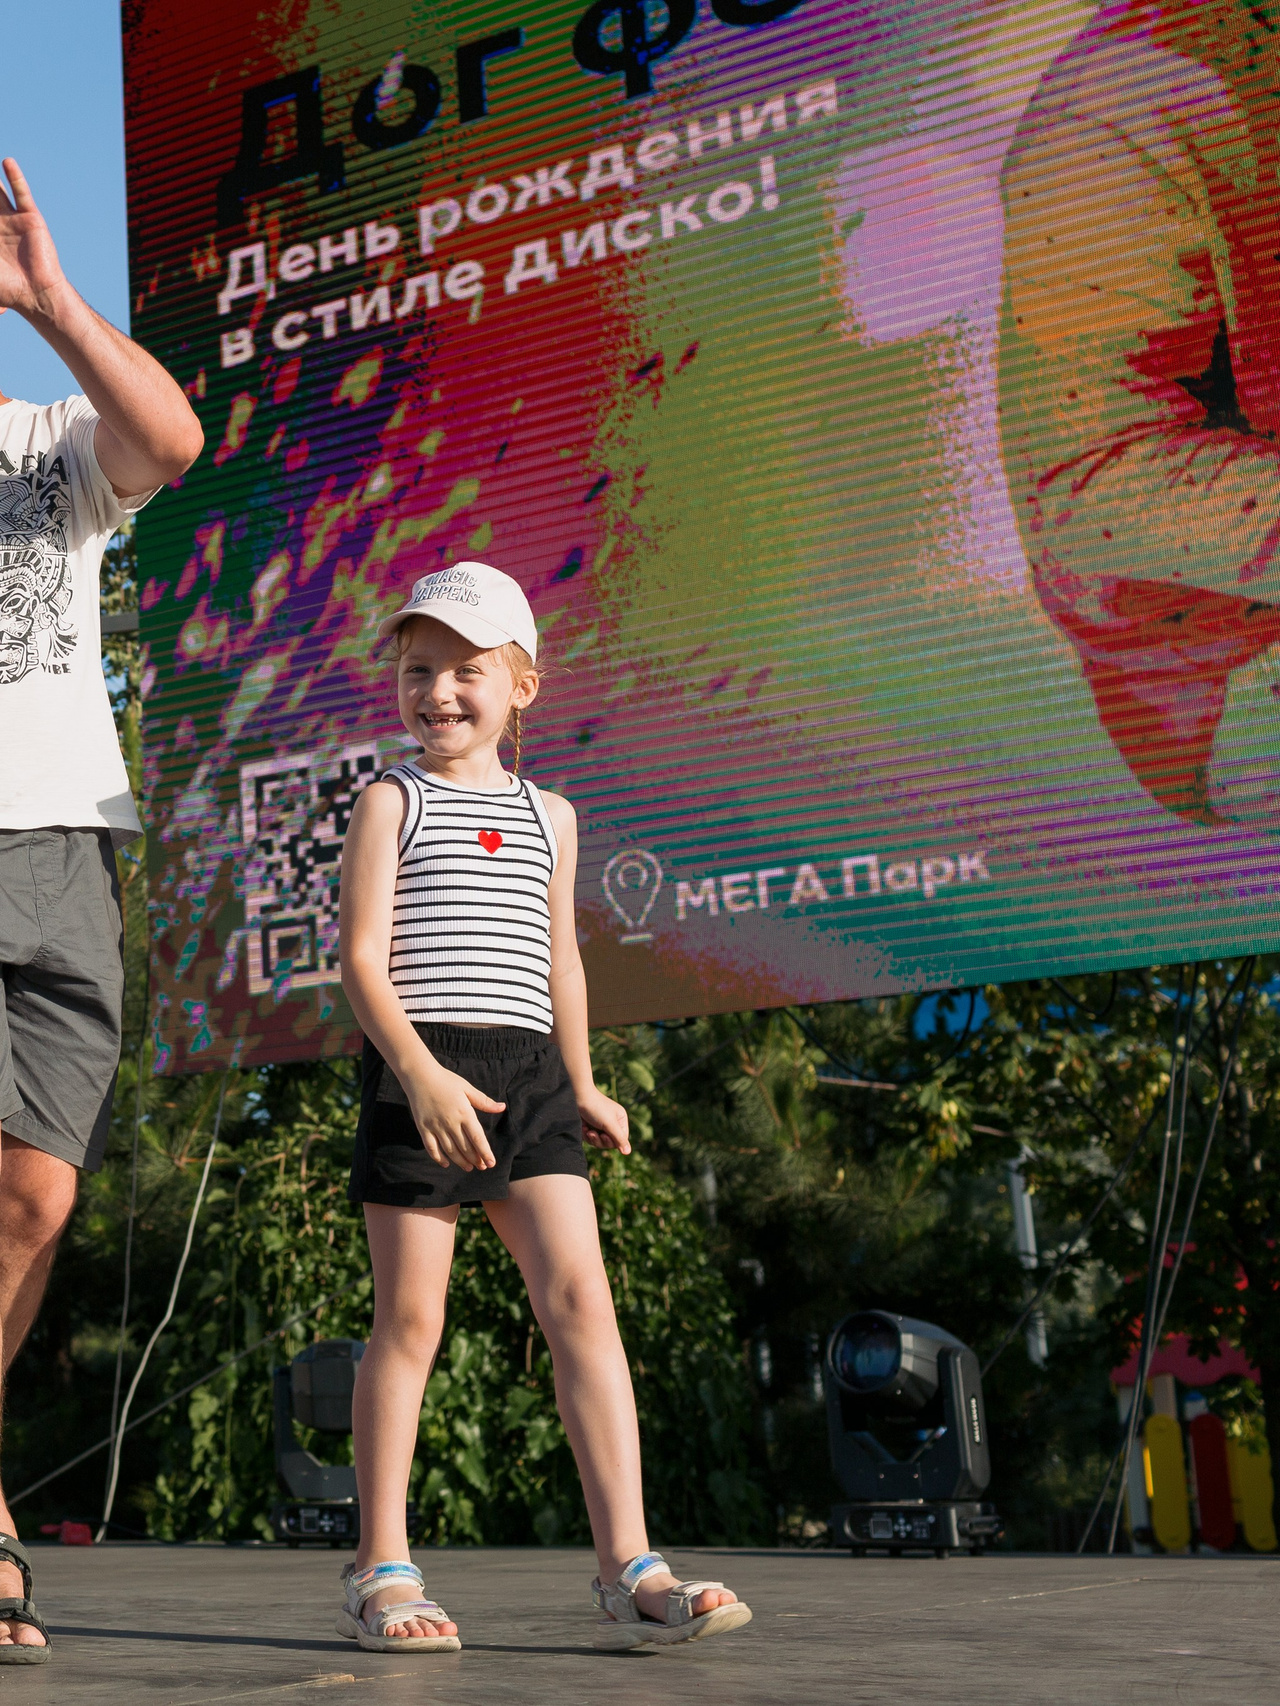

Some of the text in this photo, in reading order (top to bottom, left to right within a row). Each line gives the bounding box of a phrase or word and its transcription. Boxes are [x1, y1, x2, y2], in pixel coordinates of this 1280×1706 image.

[217, 77, 838, 314] День рождения
[221, 155, 782, 368] в стиле диско!
[412, 584, 481, 606] HAPPENS
[426, 569, 477, 587] MAGIC
[674, 850, 991, 921] МЕГА Парк
